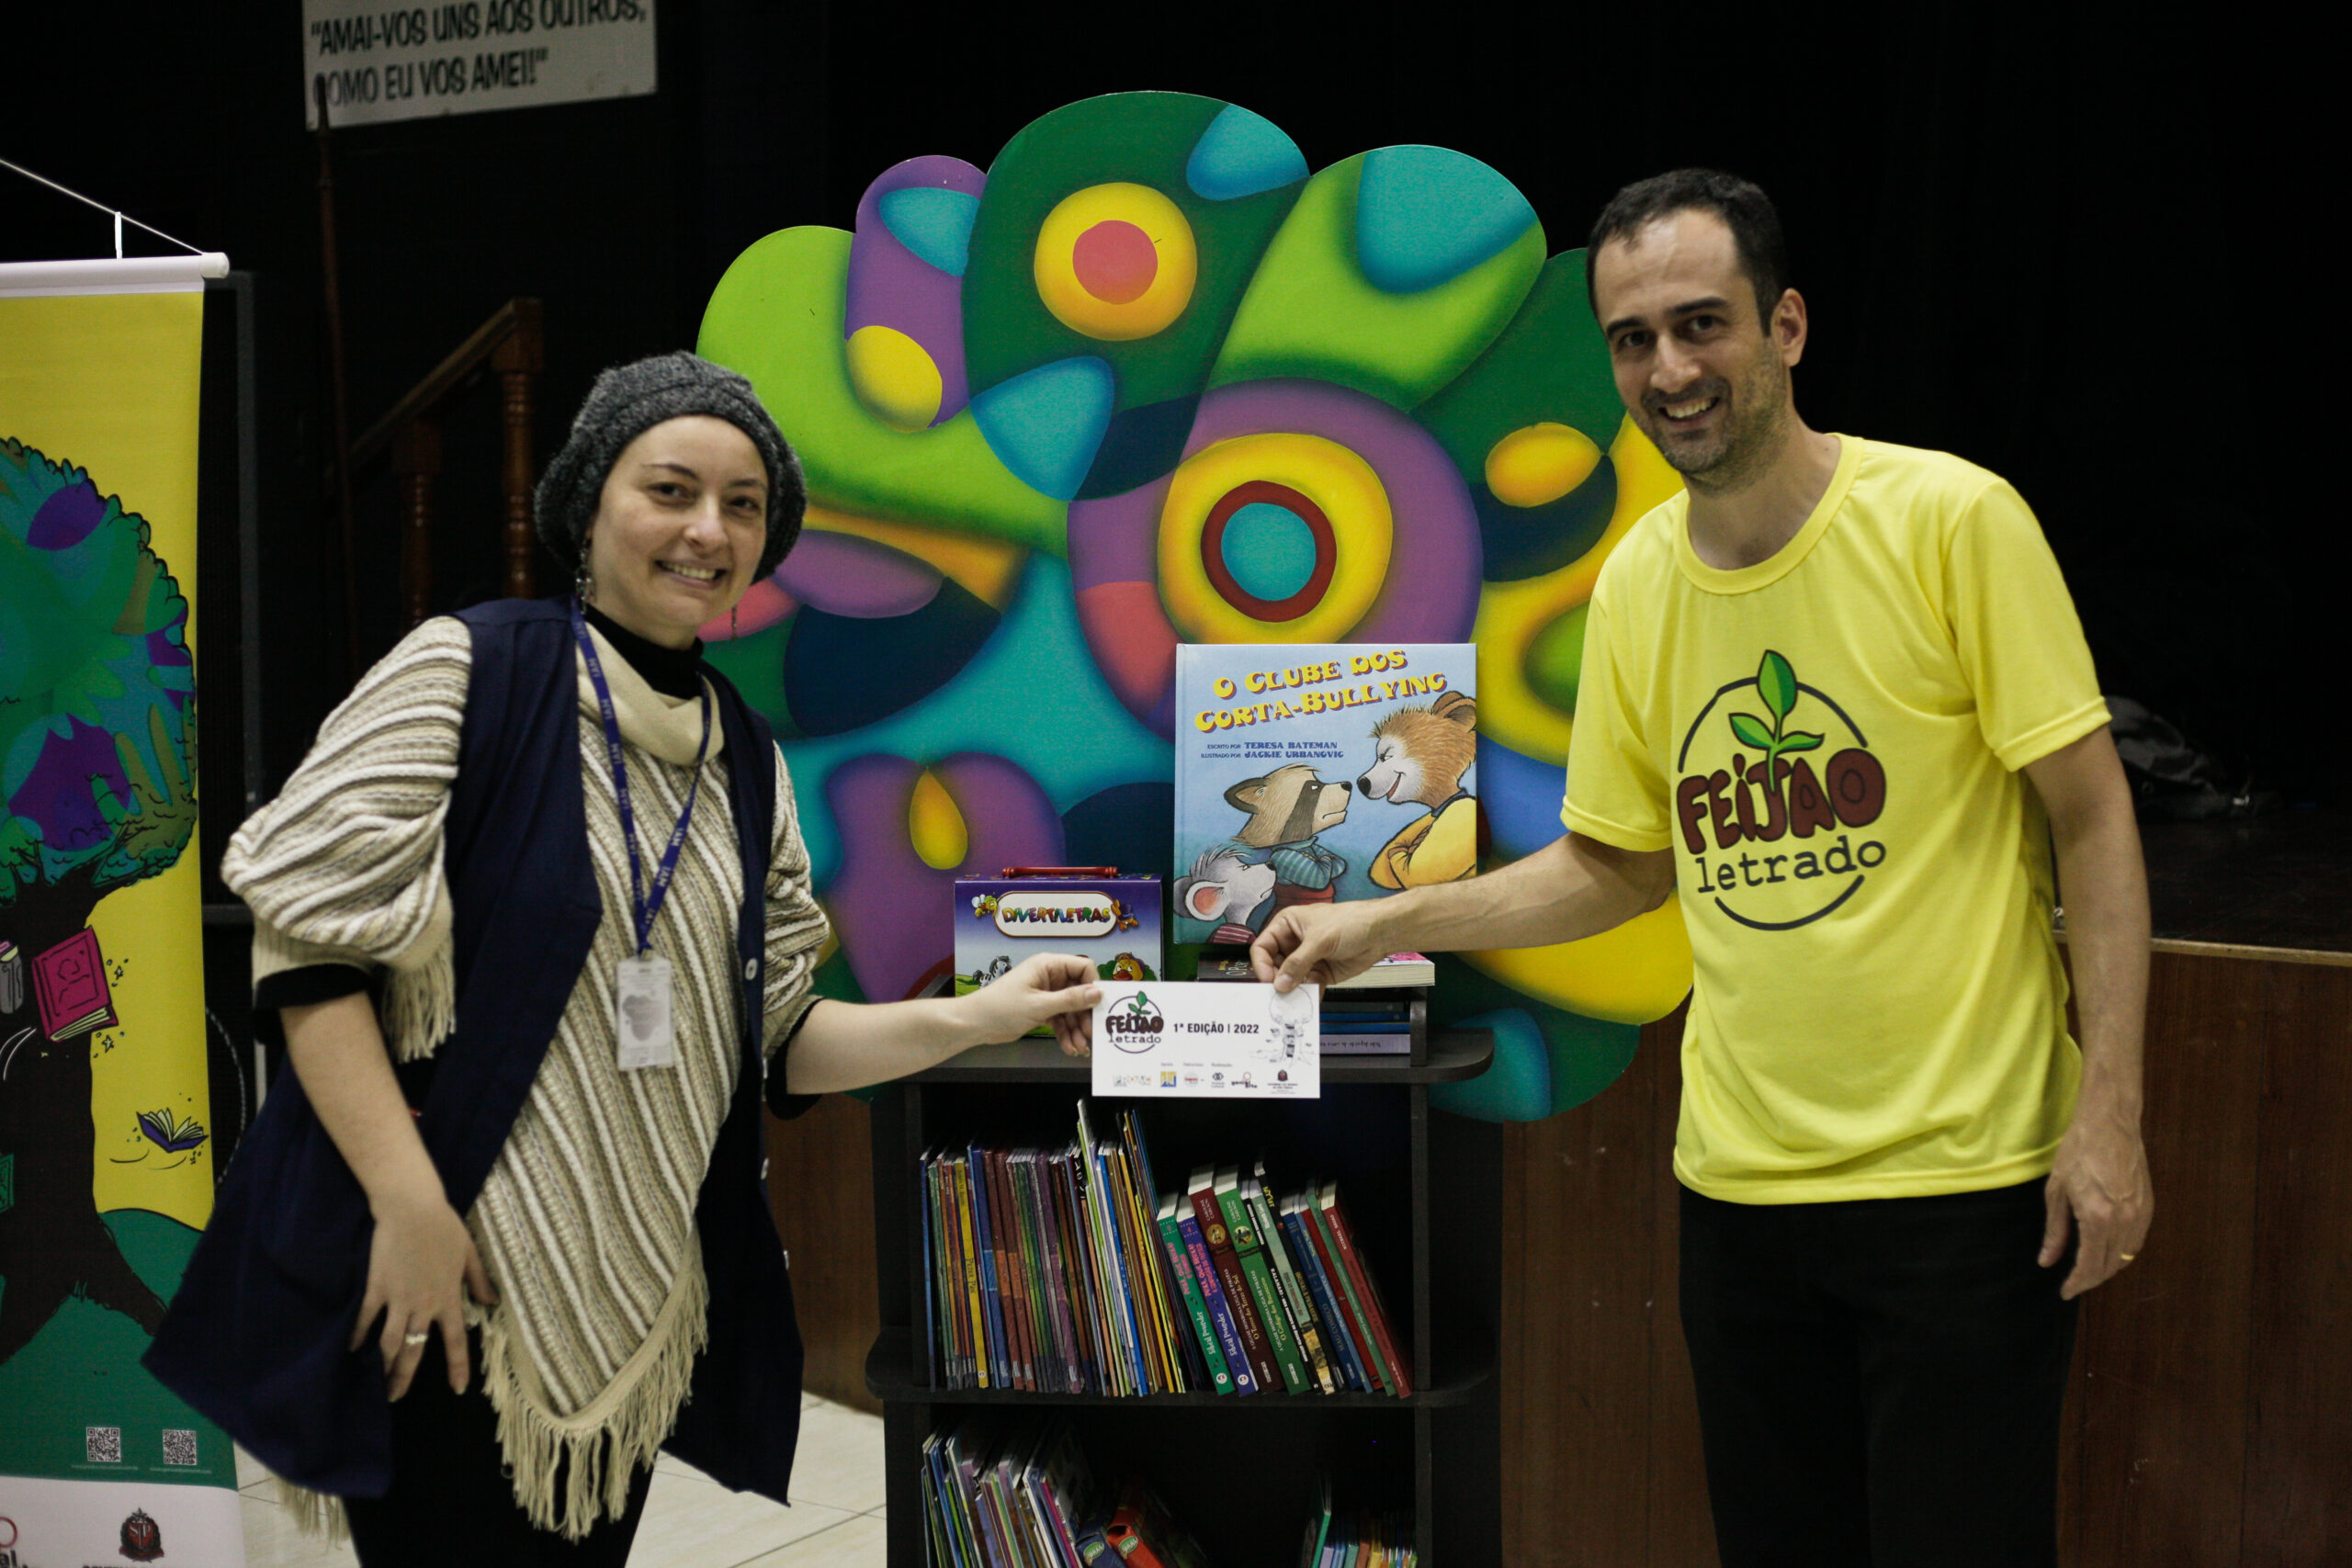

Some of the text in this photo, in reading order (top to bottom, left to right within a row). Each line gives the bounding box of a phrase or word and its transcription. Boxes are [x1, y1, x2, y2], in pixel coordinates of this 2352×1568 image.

[433, 7, 480, 42] UNS
[485, 0, 534, 36] AOS
[385, 63, 414, 99] EU
[419, 57, 466, 94] VOS
[1214, 649, 1408, 698] O CLUBE DOS
[1194, 672, 1447, 732] CORTA-BULLYING
[1244, 741, 1284, 750] TERESA
[1288, 741, 1338, 750] BATEMAN
[1244, 750, 1283, 760] JACKIE
[1286, 750, 1344, 760] URBANOVIC
[1696, 835, 1885, 893] letrado
[1109, 1034, 1161, 1043] letrado
[1187, 1021, 1224, 1036] EDIÇÃO
[1234, 1024, 1260, 1033] 2022
